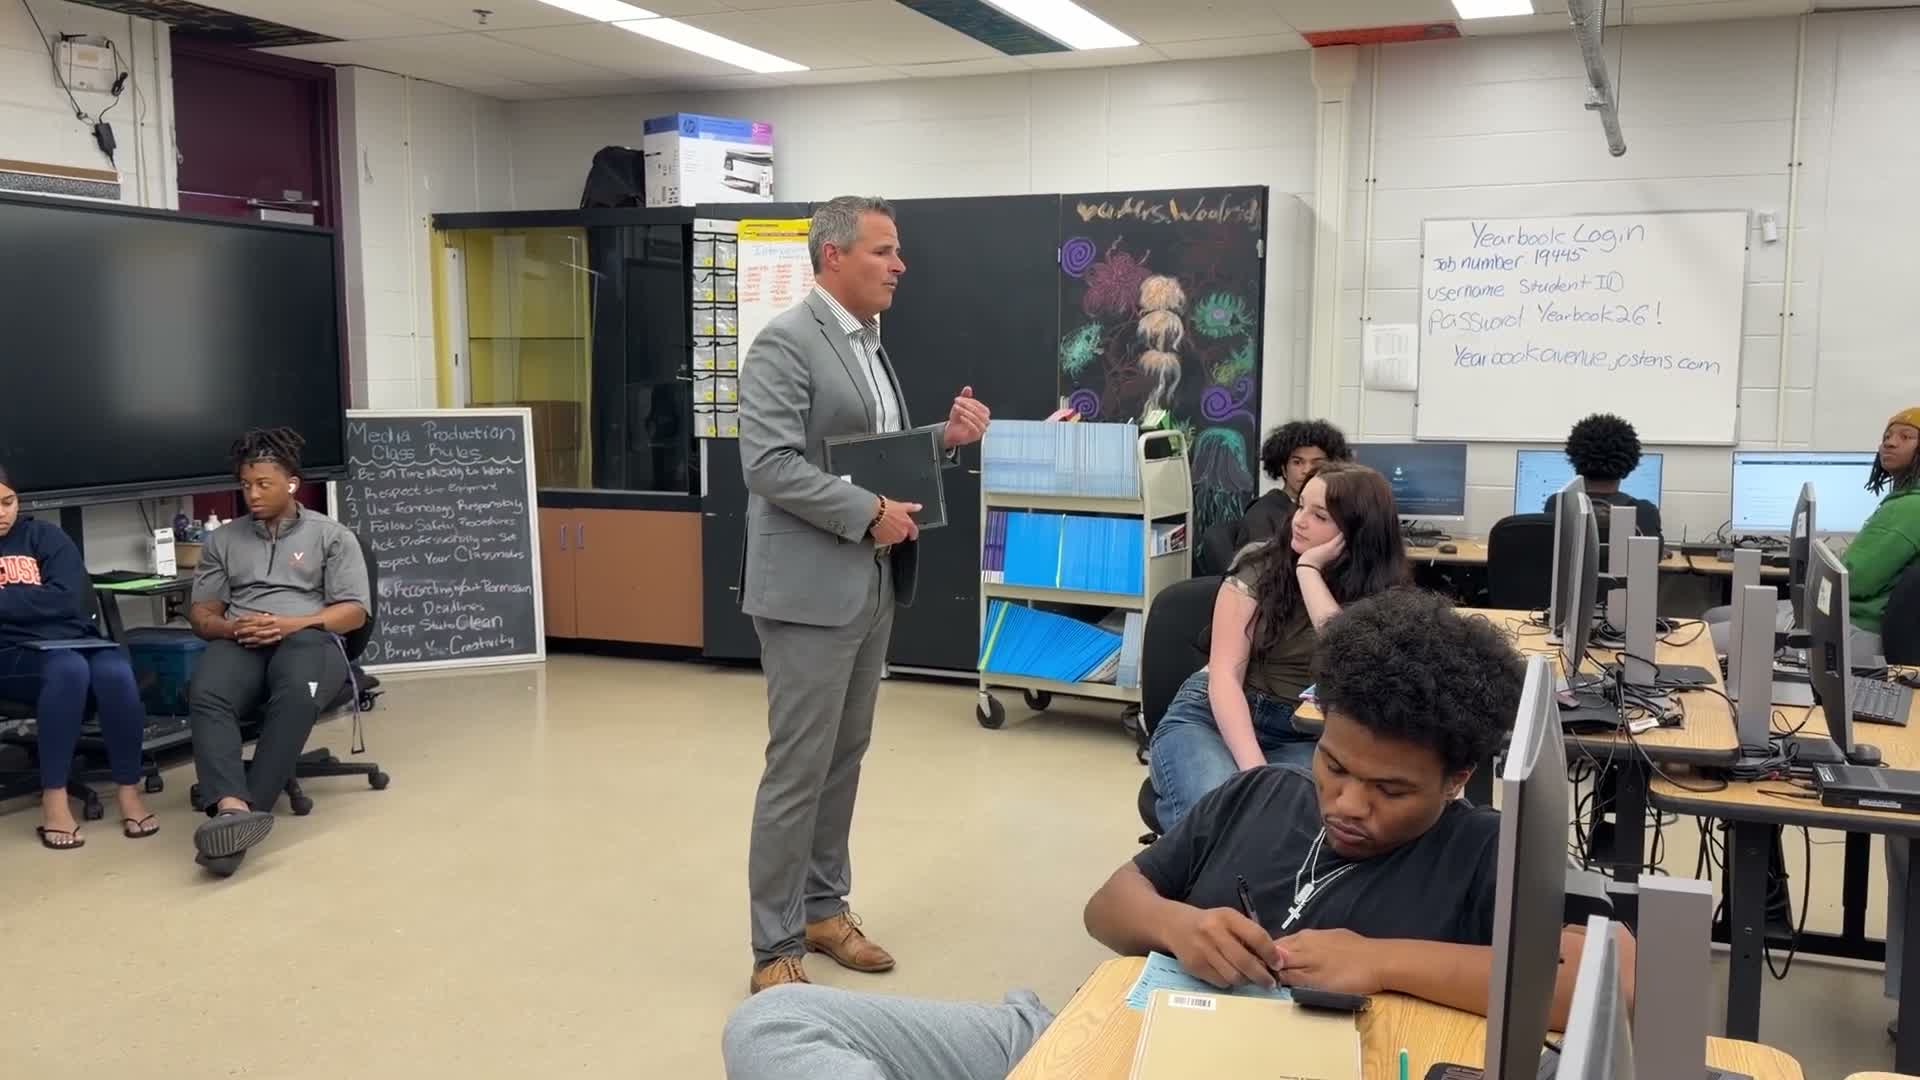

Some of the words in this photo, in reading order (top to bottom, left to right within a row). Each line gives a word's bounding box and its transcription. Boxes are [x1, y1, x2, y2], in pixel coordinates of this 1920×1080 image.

[1471, 221, 1567, 249] Yearbook
[1572, 223, 1645, 253] Login
[1460, 255, 1524, 271] number
[1534, 247, 1588, 267] 19445
[1518, 274, 1591, 295] Student
[1593, 270, 1624, 292] ID
[347, 421, 411, 445] Media
[421, 420, 516, 442] Production
[371, 444, 416, 461] Class
[426, 443, 482, 459] Rules
[364, 485, 421, 499] Respect
[370, 520, 413, 533] Follow
[381, 620, 416, 637] Keep
[455, 614, 503, 631] Clean
